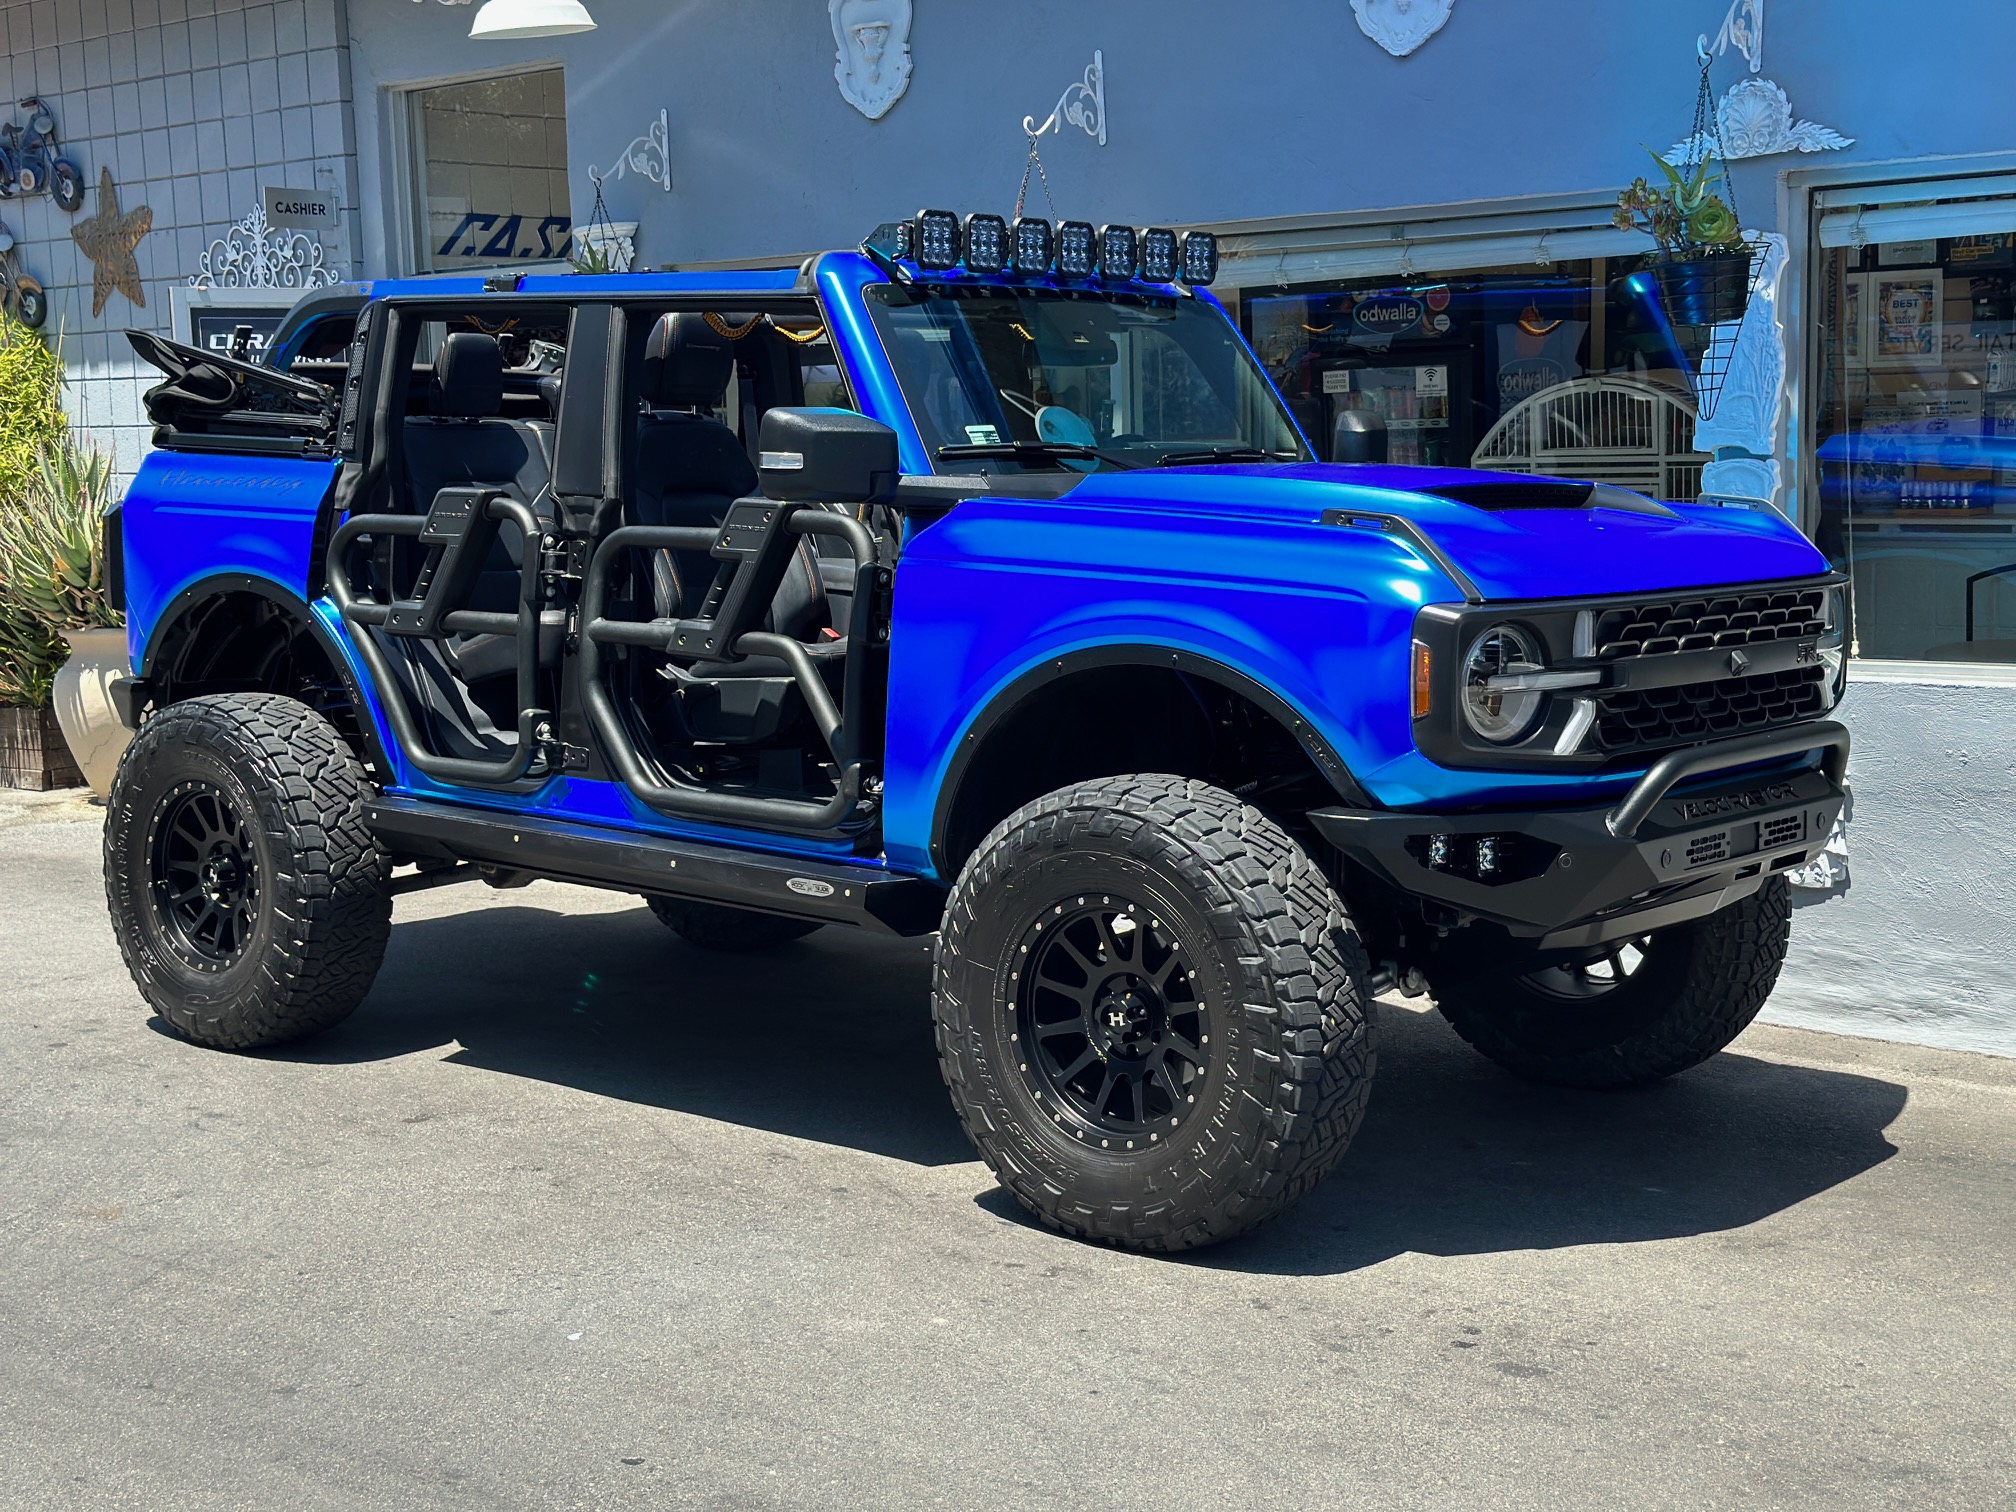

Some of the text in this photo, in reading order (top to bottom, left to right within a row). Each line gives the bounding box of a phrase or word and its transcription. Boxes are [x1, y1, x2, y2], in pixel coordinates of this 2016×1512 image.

[275, 201, 326, 216] CASHIER
[1360, 303, 1417, 322] odwalla
[1892, 298, 1919, 309] BEST
[1503, 366, 1558, 392] odwalla
[159, 468, 304, 496] Hennessey
[1673, 782, 1800, 821] VELOCIRAPTOR
[1108, 1012, 1126, 1027] H
